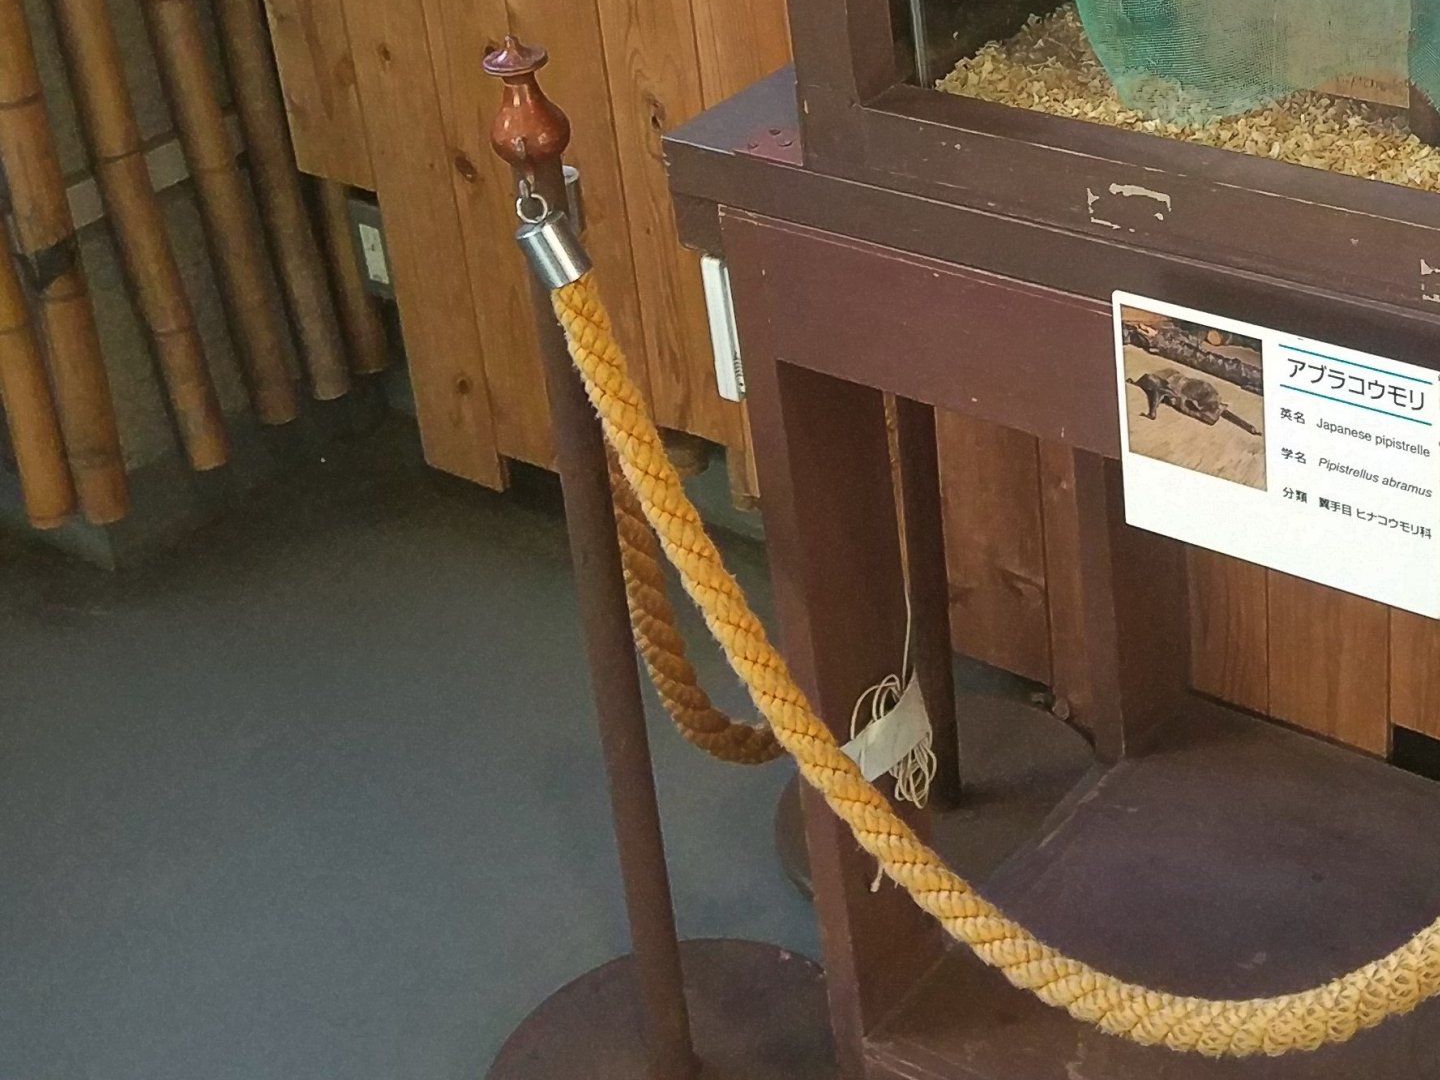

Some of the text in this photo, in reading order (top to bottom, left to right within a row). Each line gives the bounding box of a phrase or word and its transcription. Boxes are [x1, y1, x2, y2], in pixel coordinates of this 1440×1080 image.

[1287, 357, 1425, 411] アブラコウモリ
[1280, 406, 1431, 458] 英名 Japanese pipistrelle
[1280, 447, 1433, 499] 学名 Pipistrellus abramus
[1282, 486, 1433, 540] 分類 翼手目 ヒナコウモリ科
